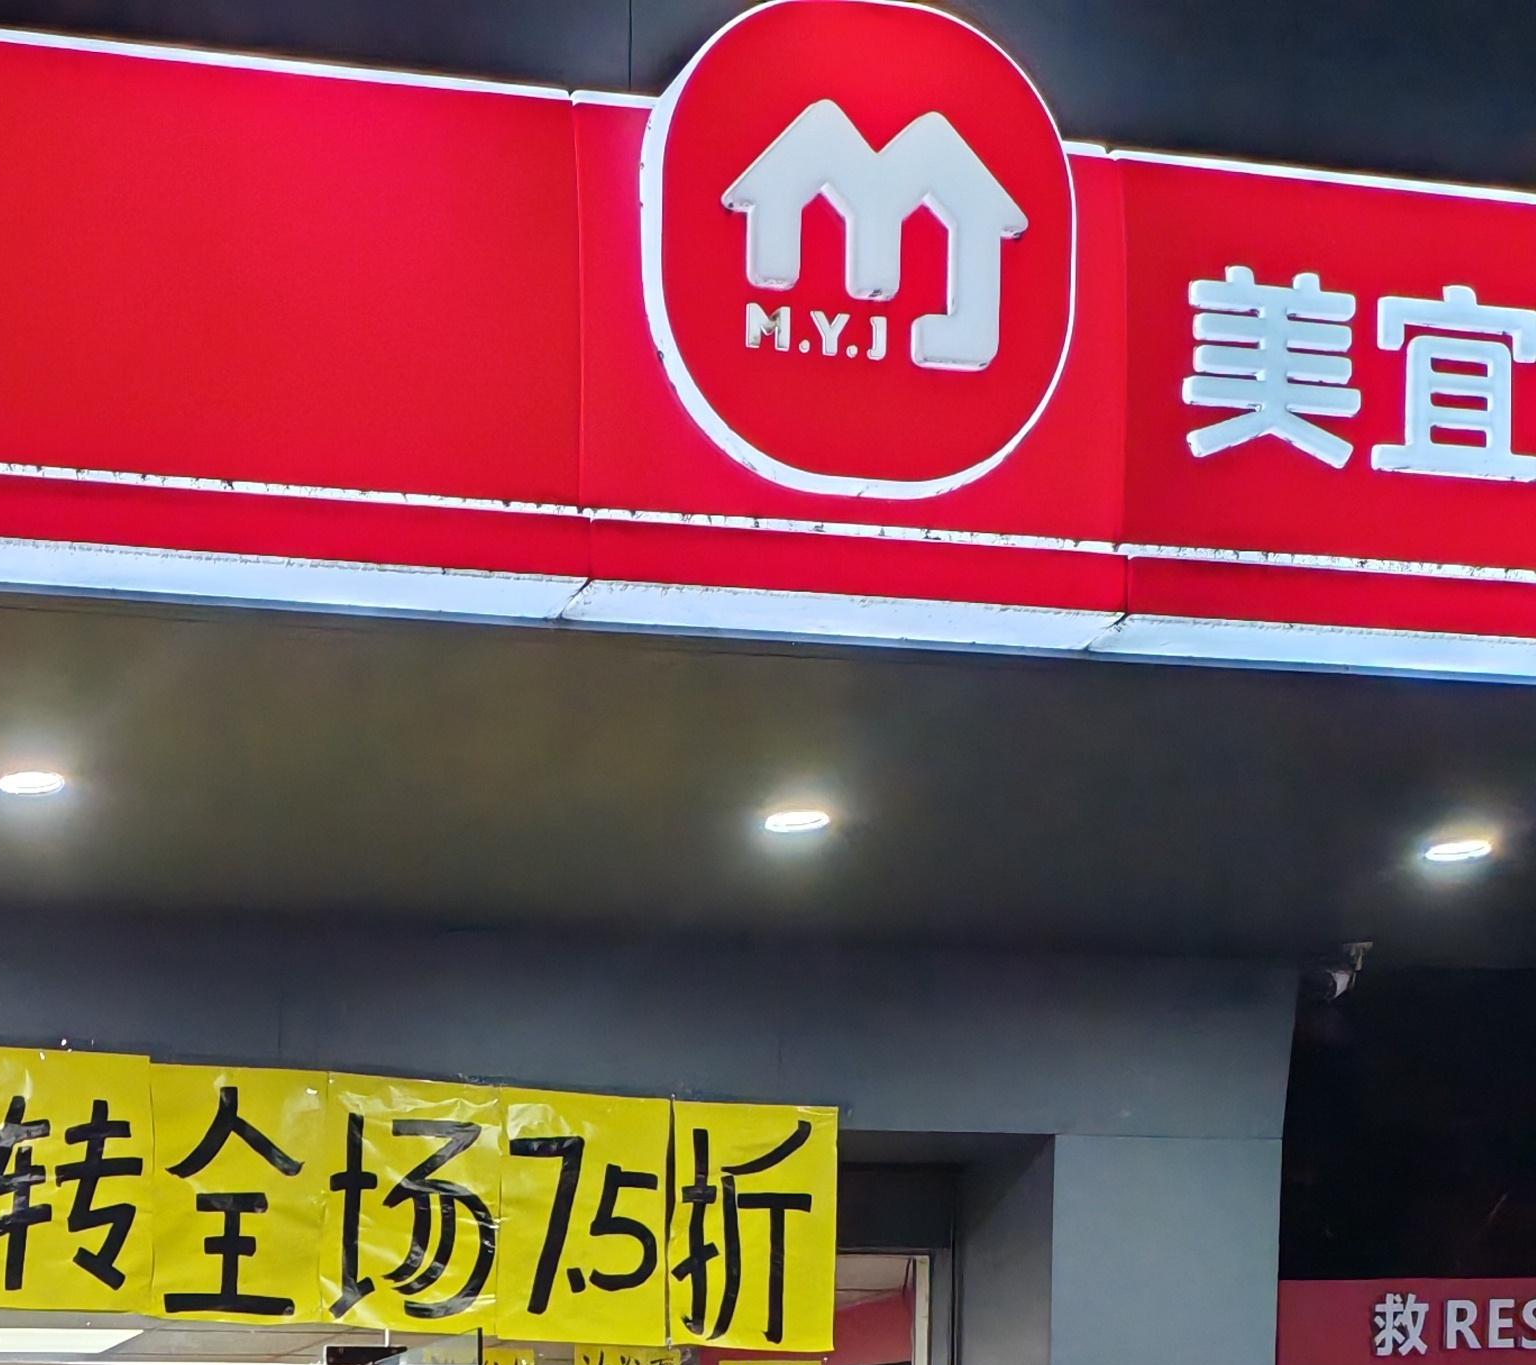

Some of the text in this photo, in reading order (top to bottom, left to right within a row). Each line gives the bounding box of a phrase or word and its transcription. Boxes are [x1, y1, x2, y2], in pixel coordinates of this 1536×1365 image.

[745, 303, 888, 361] M.Y.J
[1183, 266, 1536, 482] 美宜
[1374, 1293, 1429, 1356] 救
